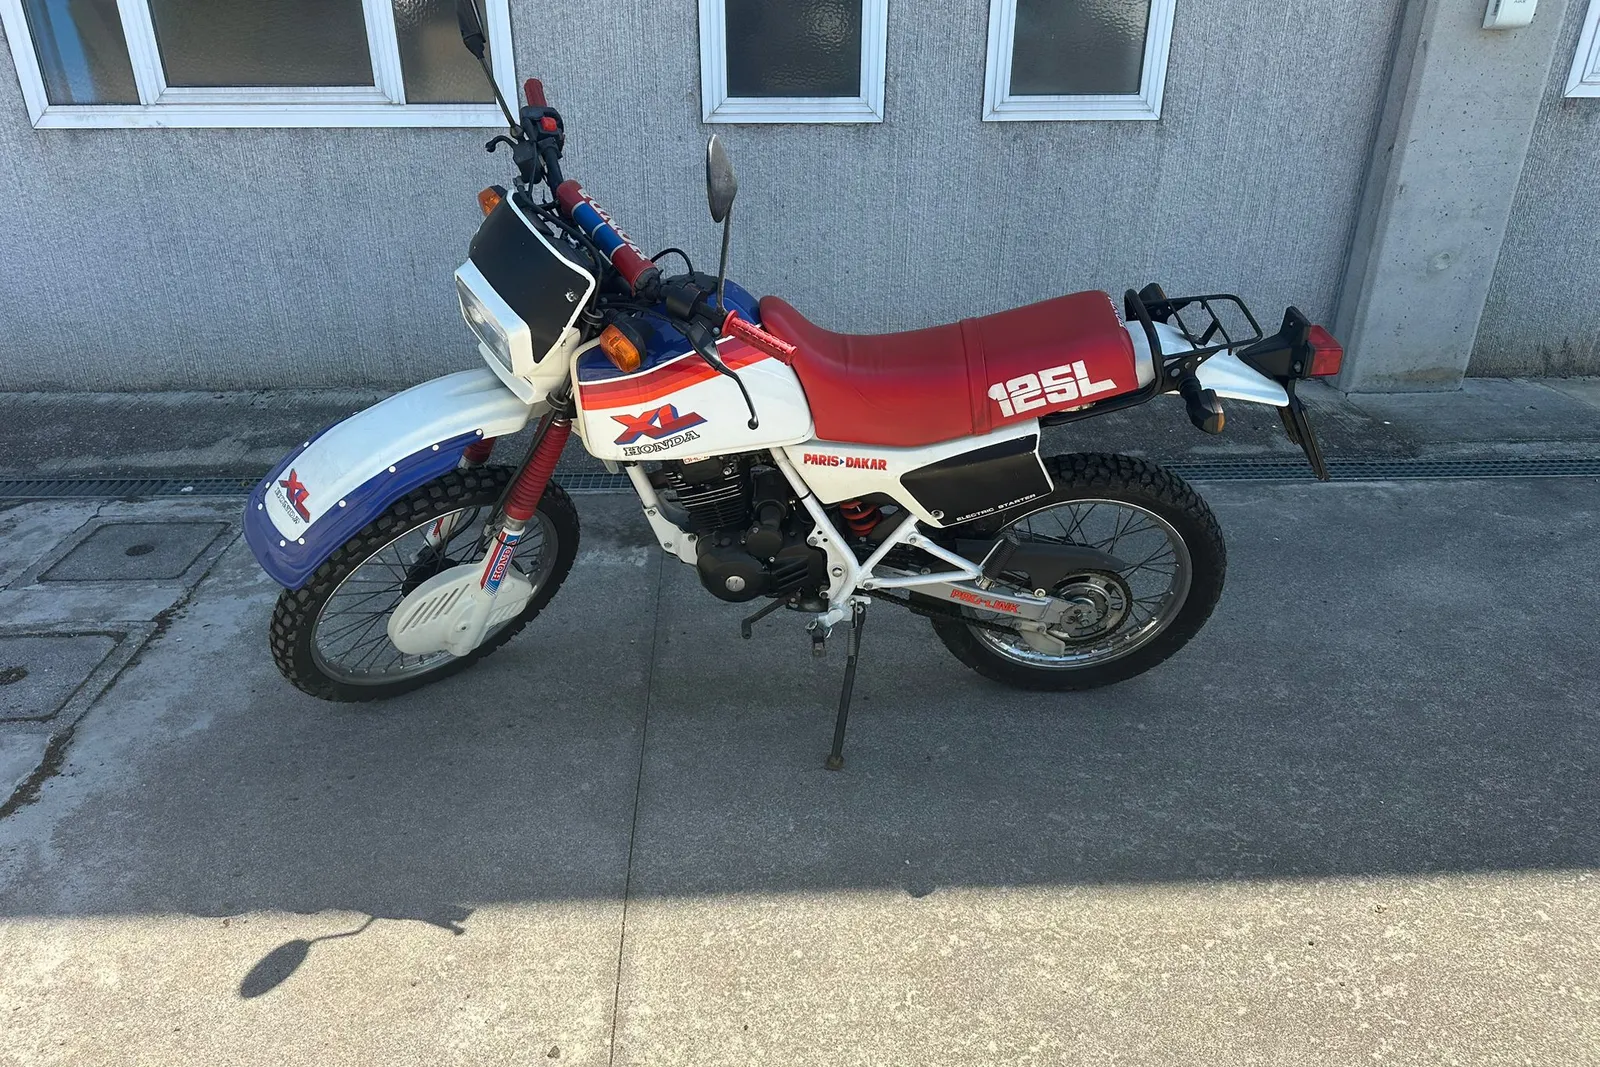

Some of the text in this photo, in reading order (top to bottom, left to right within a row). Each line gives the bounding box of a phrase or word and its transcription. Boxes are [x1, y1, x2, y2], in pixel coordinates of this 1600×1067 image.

[988, 360, 1117, 417] 125L
[610, 403, 708, 445] XL
[623, 430, 700, 456] HONDA
[803, 453, 887, 471] PARIS DAKAR
[278, 468, 310, 523] XL
[956, 493, 1036, 521] ELECTRIC STARTER
[491, 539, 518, 580] HONDA
